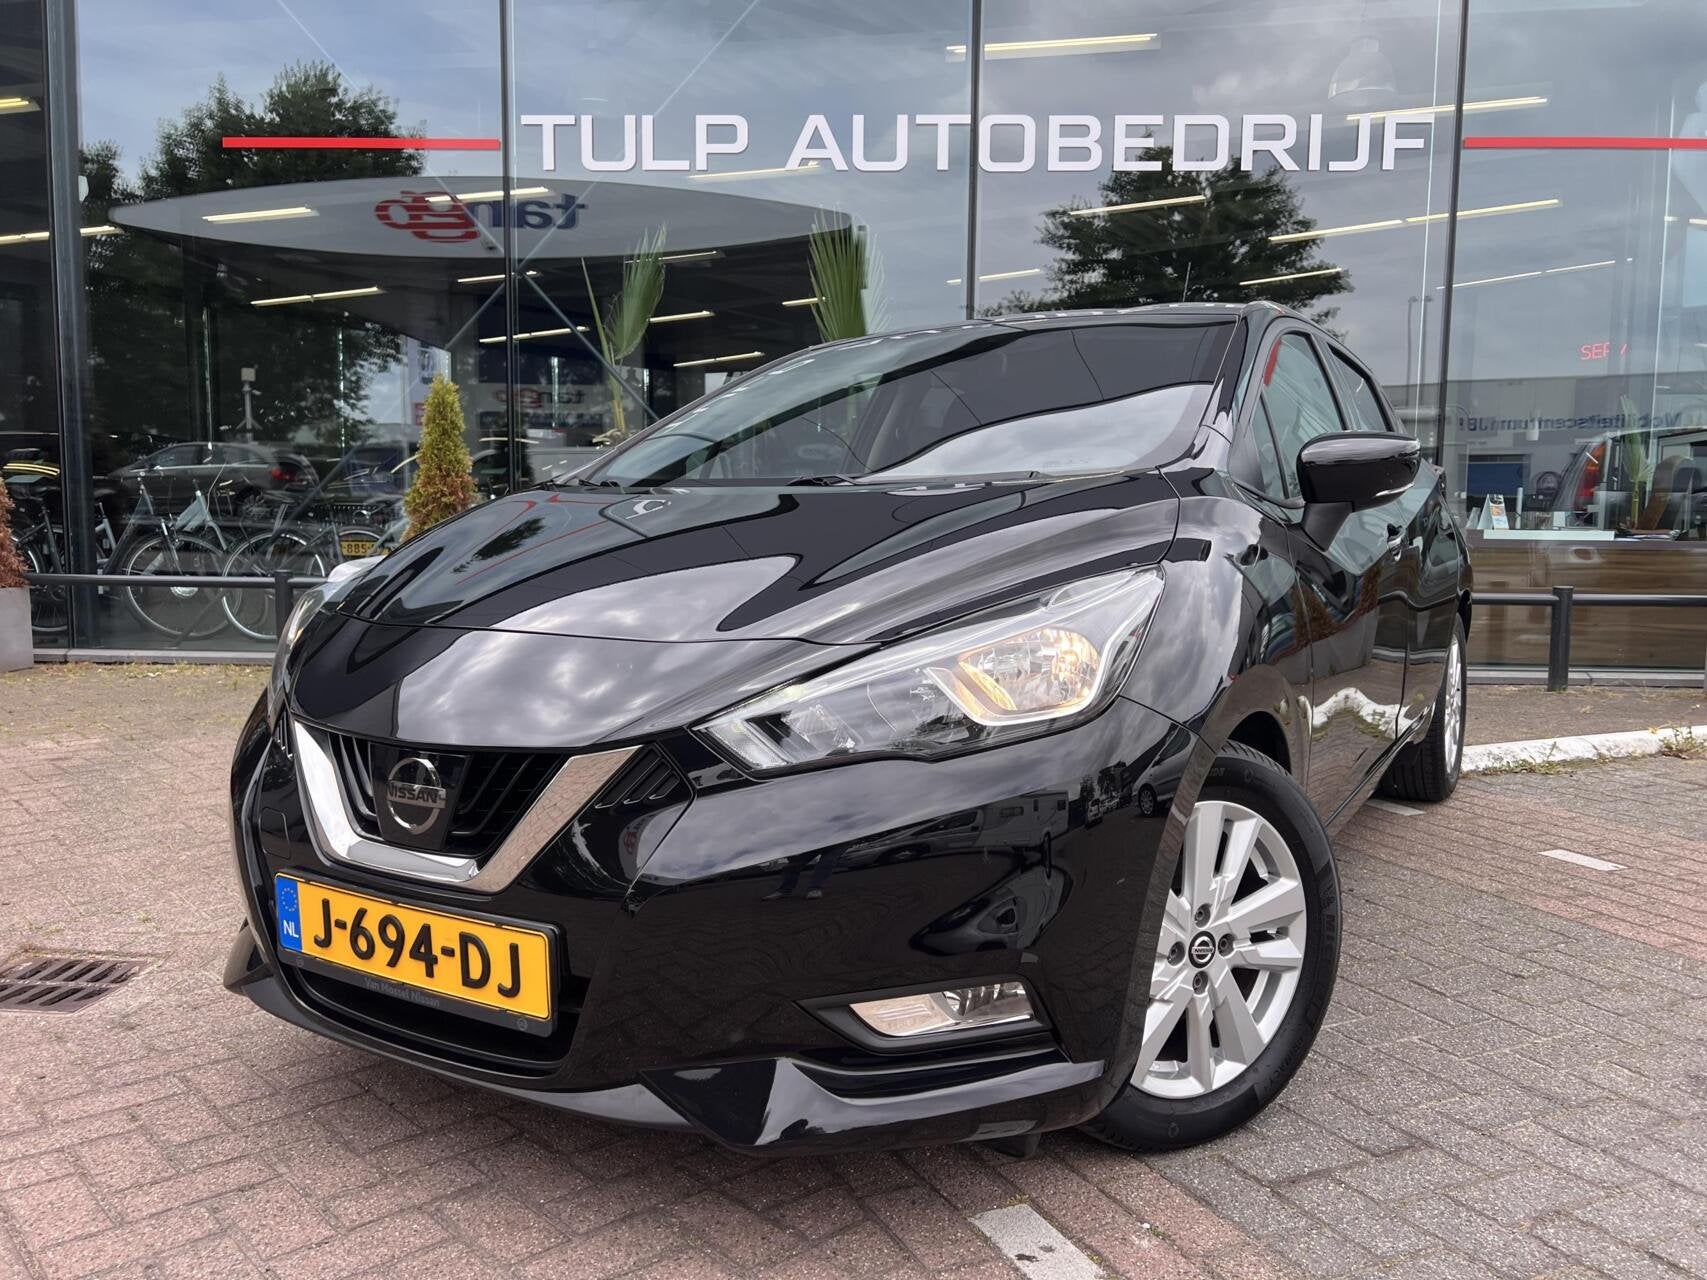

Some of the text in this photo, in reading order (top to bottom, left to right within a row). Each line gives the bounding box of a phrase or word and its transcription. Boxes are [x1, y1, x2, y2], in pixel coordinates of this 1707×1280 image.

[520, 113, 1435, 172] TULP AUTOBEDRIJF
[387, 782, 439, 804] NISSAN
[283, 920, 299, 938] NL
[313, 897, 521, 998] J-694-DJ
